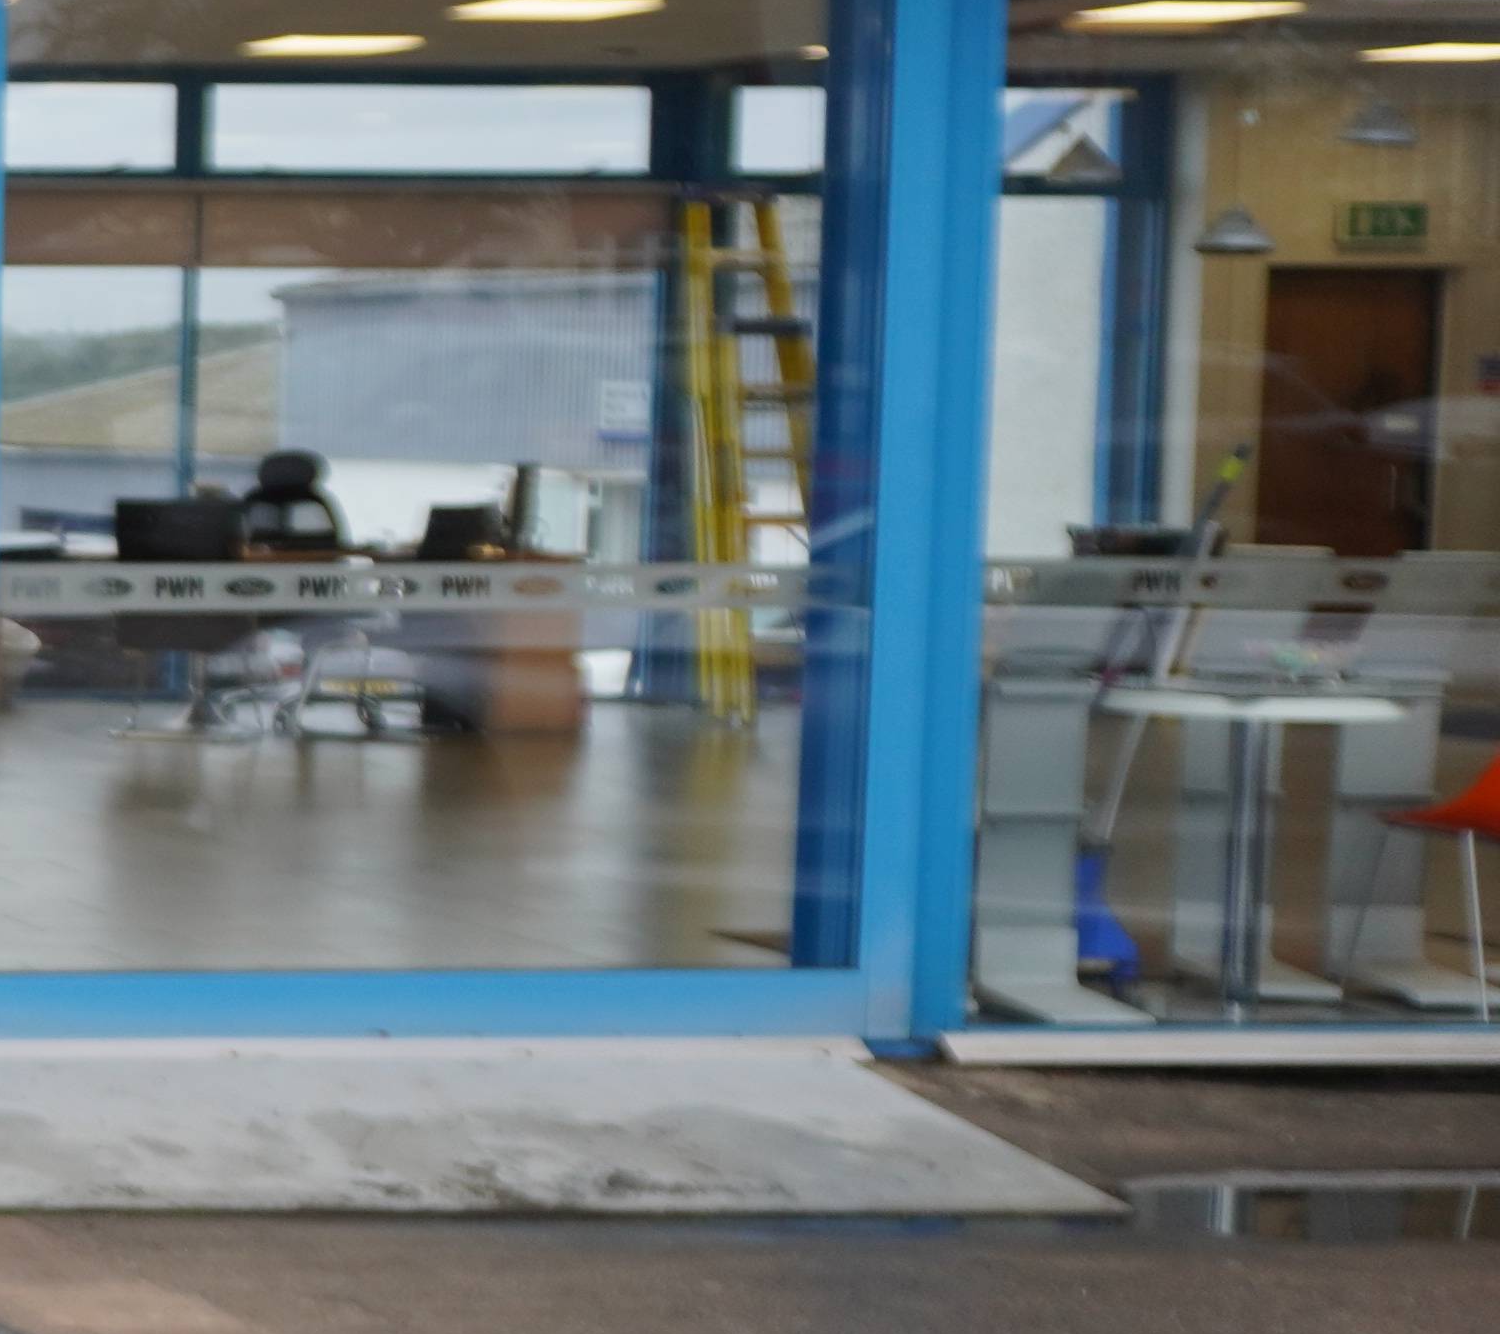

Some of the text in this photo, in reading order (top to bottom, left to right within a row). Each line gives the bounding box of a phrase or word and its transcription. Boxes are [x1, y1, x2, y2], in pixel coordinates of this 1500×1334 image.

[154, 576, 205, 598] PWM
[299, 575, 349, 598] PWM
[441, 575, 492, 597] PWM
